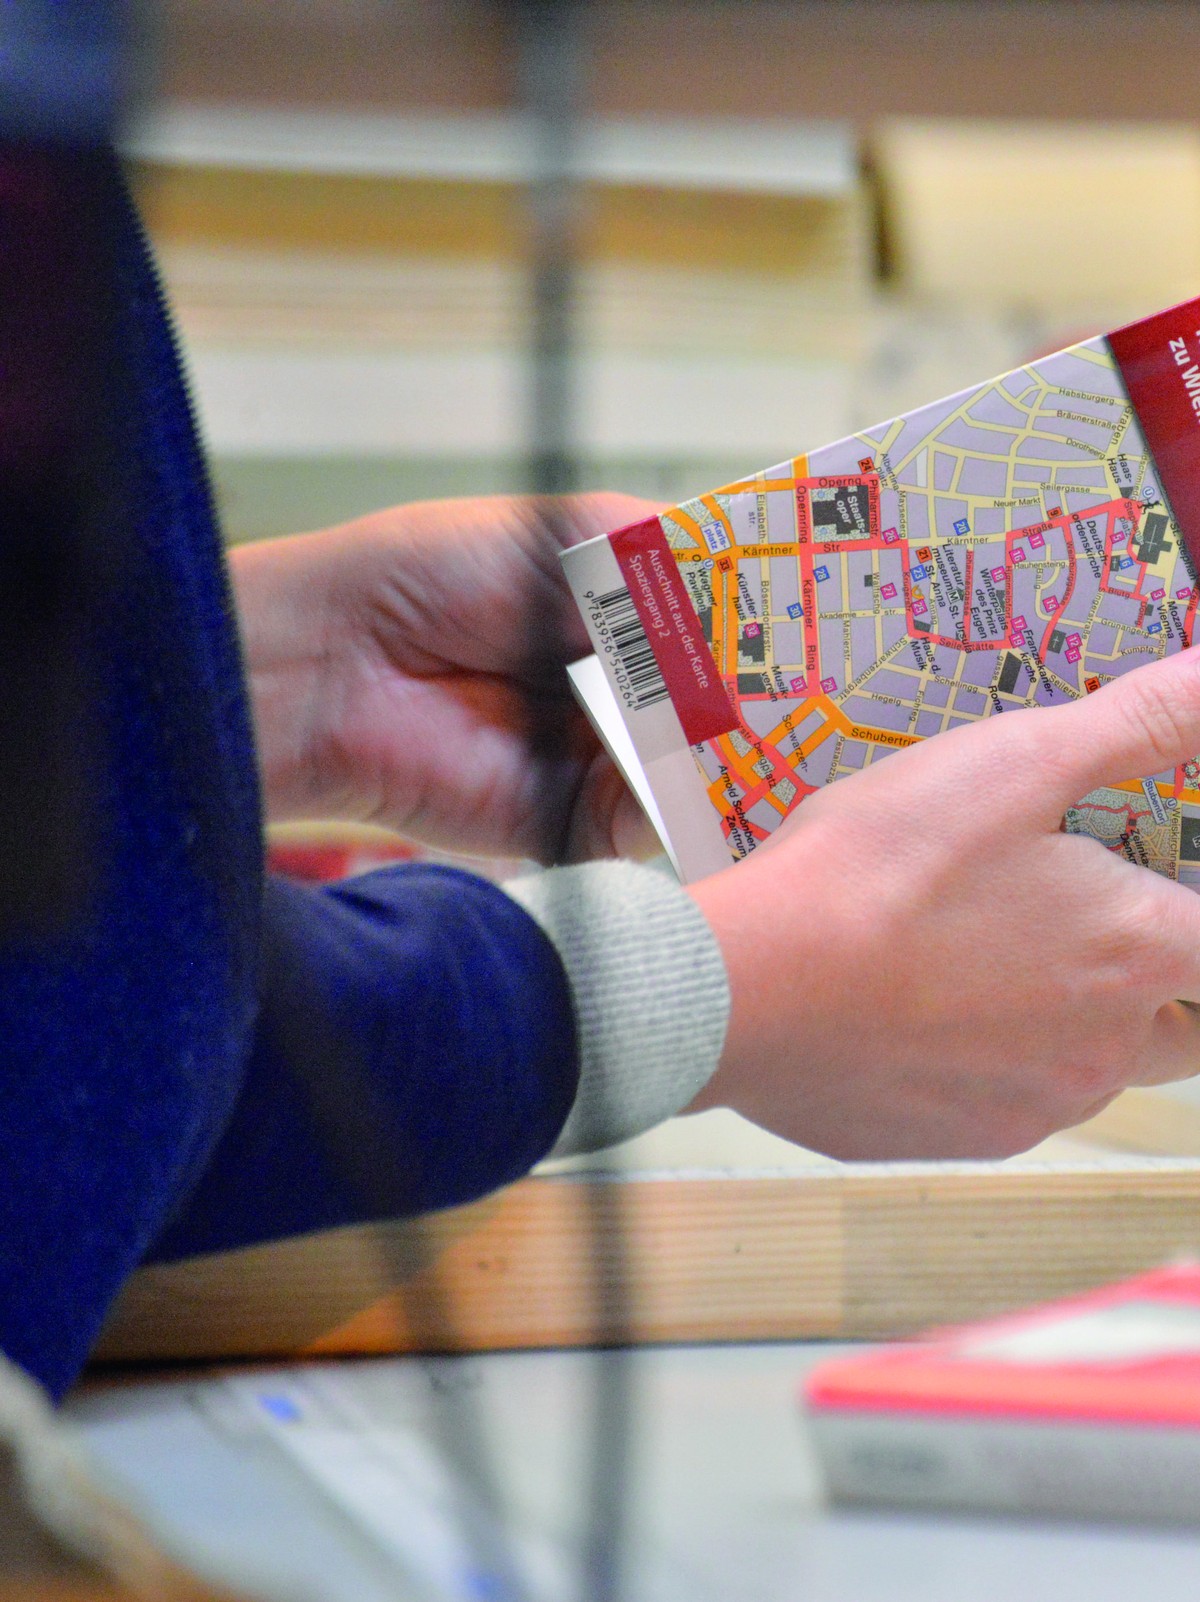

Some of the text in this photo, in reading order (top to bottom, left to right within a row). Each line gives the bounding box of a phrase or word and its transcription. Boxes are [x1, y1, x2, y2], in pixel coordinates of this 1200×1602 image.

[1168, 336, 1191, 366] zu
[1110, 406, 1133, 445] Graben
[861, 460, 872, 471] 24
[875, 467, 888, 488] platz
[1106, 458, 1121, 484] Haus
[1117, 453, 1133, 483] Haas-
[1019, 497, 1041, 506] Markt
[1040, 483, 1091, 493] Seilergasse
[757, 494, 767, 543] Elisabeth-
[796, 485, 808, 544] Opernring
[836, 500, 852, 524] oper
[848, 495, 866, 533] Staats-
[704, 528, 718, 550] platz
[713, 521, 727, 548] Karls-
[742, 543, 845, 556] Kärntner Str.
[946, 522, 1053, 545] Kärntner Straße
[1072, 514, 1102, 579] ordenskirche
[1087, 520, 1109, 566] Deutsch-
[719, 559, 730, 571] 33
[918, 549, 929, 560] 21
[629, 554, 671, 638] Spaziergang 2
[735, 572, 758, 620] Künstler-
[925, 565, 946, 608] St. Anna
[980, 568, 1009, 631] Winterpalais
[648, 549, 709, 690] Ausschnitt aus der Karte
[732, 597, 747, 621] haus
[803, 579, 816, 671] Kärntner Ring
[948, 605, 959, 620] St.
[970, 606, 988, 640] Eugen
[975, 588, 998, 635] des Prinz
[1157, 604, 1174, 639] Vienna
[1167, 600, 1190, 648] Mozartha
[583, 591, 637, 708] 9 783956 540264
[910, 640, 928, 671] Musik
[921, 636, 936, 662] Haus
[1023, 629, 1053, 698] Franziskaner-
[771, 665, 788, 700] Musik-
[1020, 652, 1037, 684] kirche
[761, 671, 778, 703] verein
[782, 714, 809, 774] Schwarzen-
[718, 764, 738, 798] Arnold
[753, 741, 778, 790] bergplatz
[1144, 780, 1166, 824] Stubentor
[725, 814, 748, 858] Zentrum
